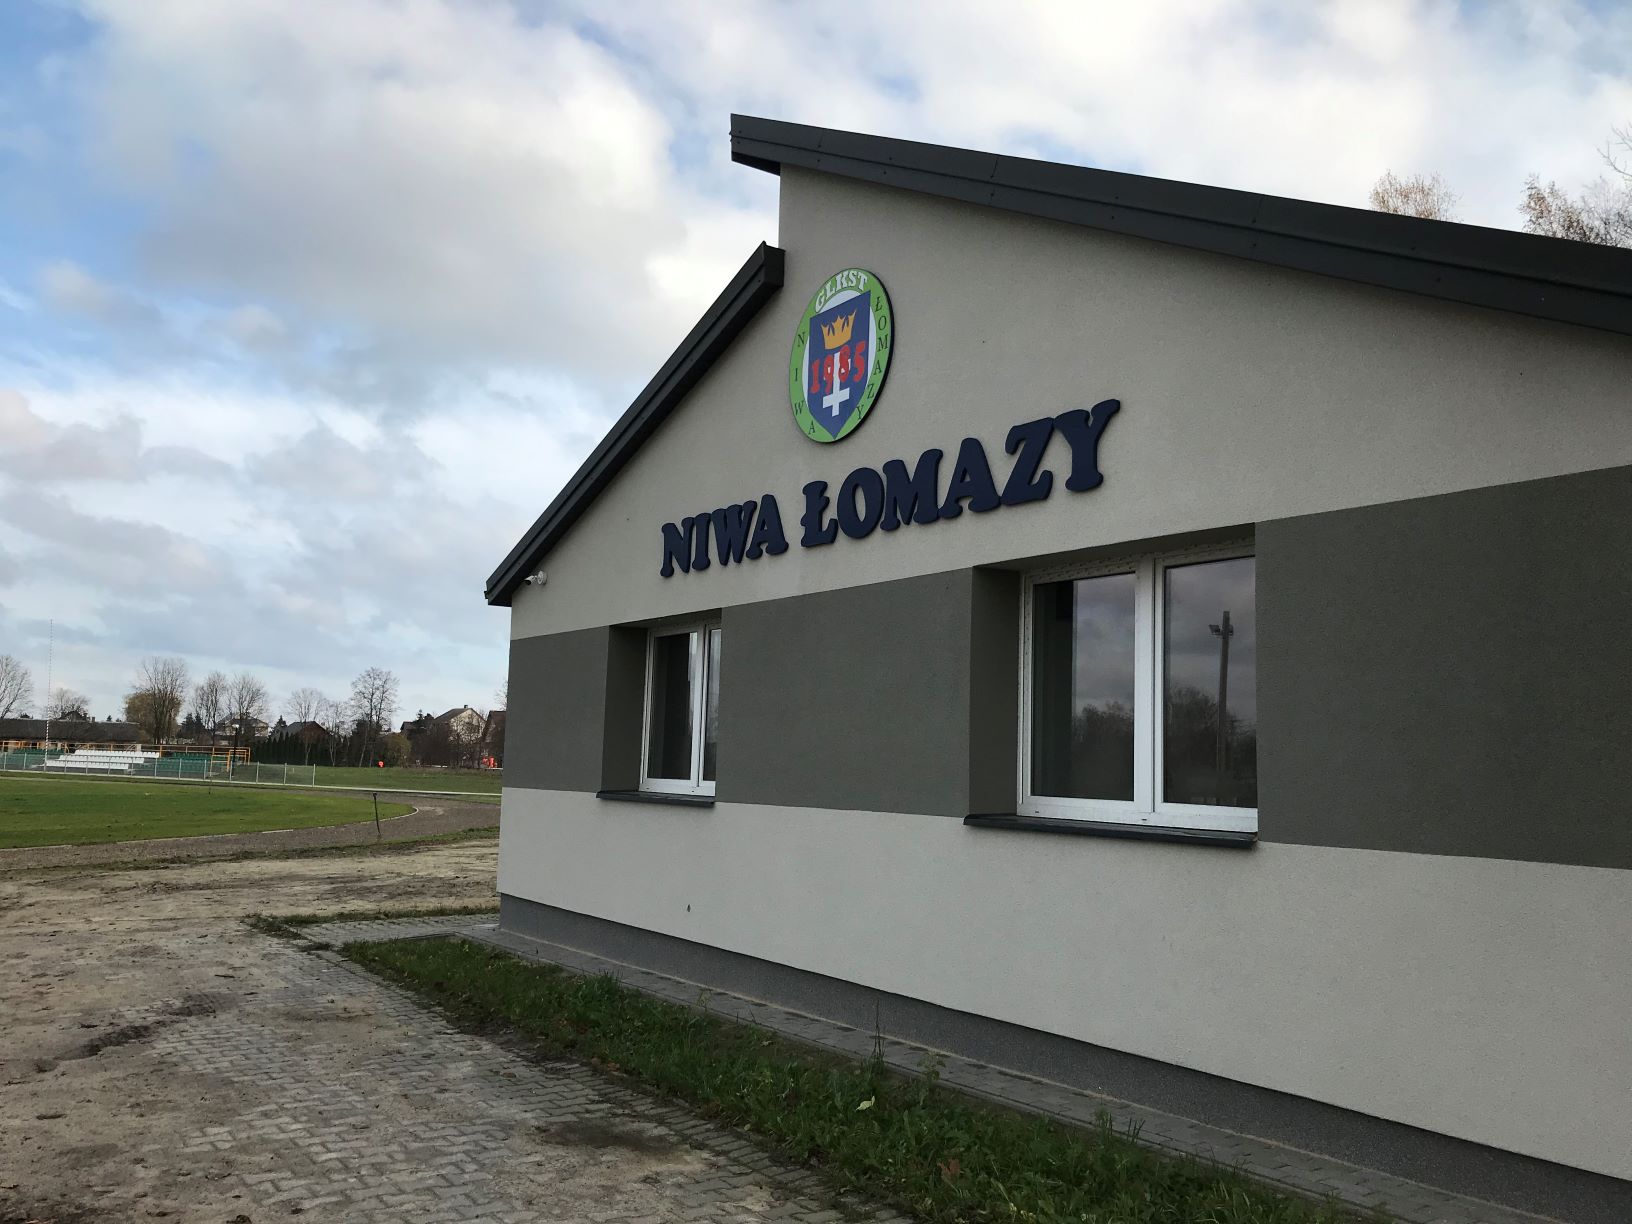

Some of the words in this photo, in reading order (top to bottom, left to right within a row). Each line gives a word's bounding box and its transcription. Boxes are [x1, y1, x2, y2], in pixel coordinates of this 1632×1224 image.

[794, 331, 816, 435] NIWA
[810, 340, 866, 394] 1985
[660, 494, 789, 577] NIWA
[800, 398, 1120, 548] ŁOMAZY
